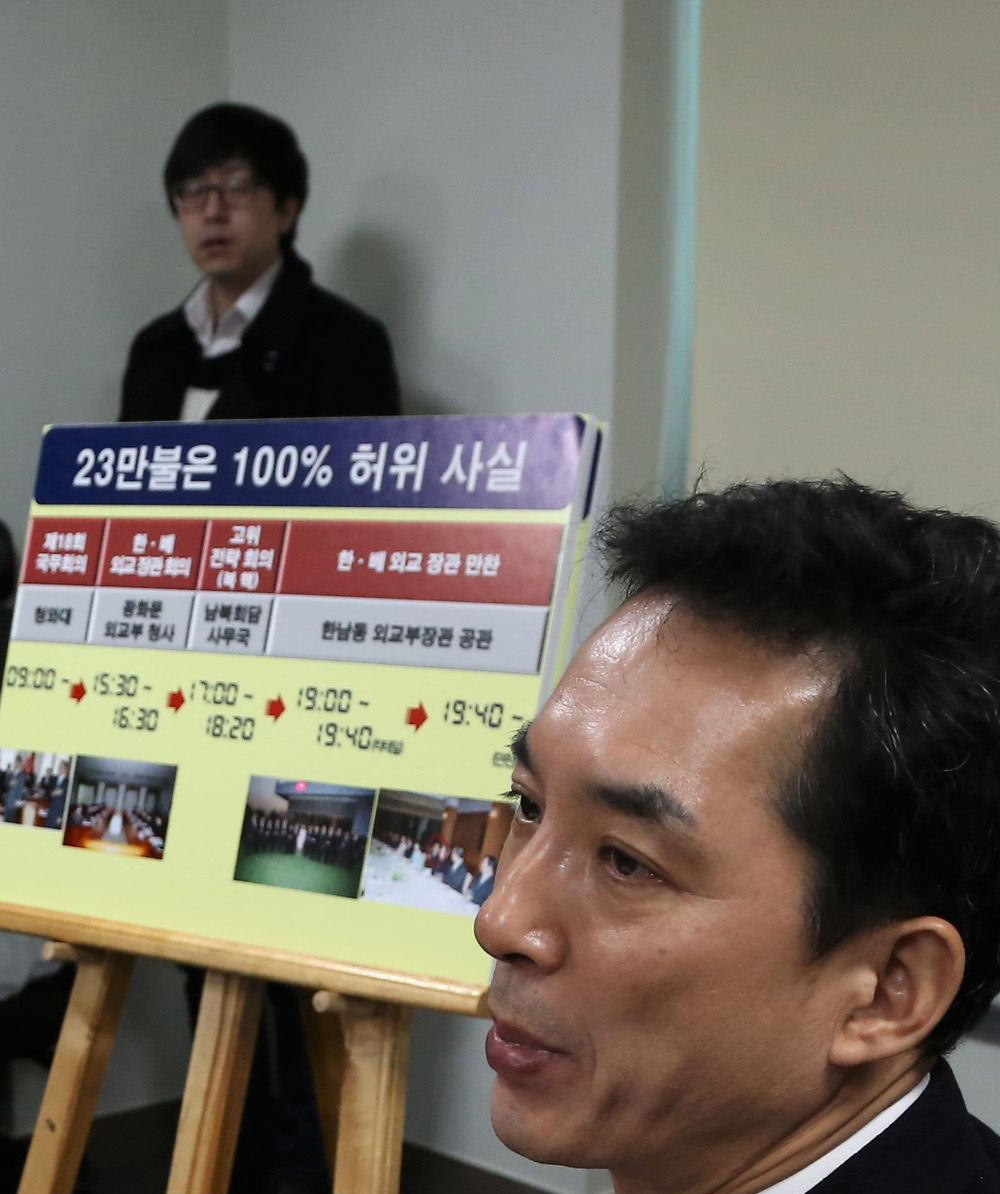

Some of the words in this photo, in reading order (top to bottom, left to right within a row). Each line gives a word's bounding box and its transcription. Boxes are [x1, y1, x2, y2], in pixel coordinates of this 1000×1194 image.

[72, 445, 218, 492] 23만불은
[233, 444, 333, 488] 100%
[350, 440, 429, 493] 허위
[440, 440, 528, 493] 사실
[426, 552, 462, 575] 장관
[204, 603, 262, 623] 남북회담
[104, 621, 143, 640] 외교부
[148, 623, 176, 642] 청사
[207, 626, 252, 646] 사무국
[321, 619, 368, 643] 한남동
[373, 623, 455, 649] 외교부장관
[459, 627, 494, 650] 공관
